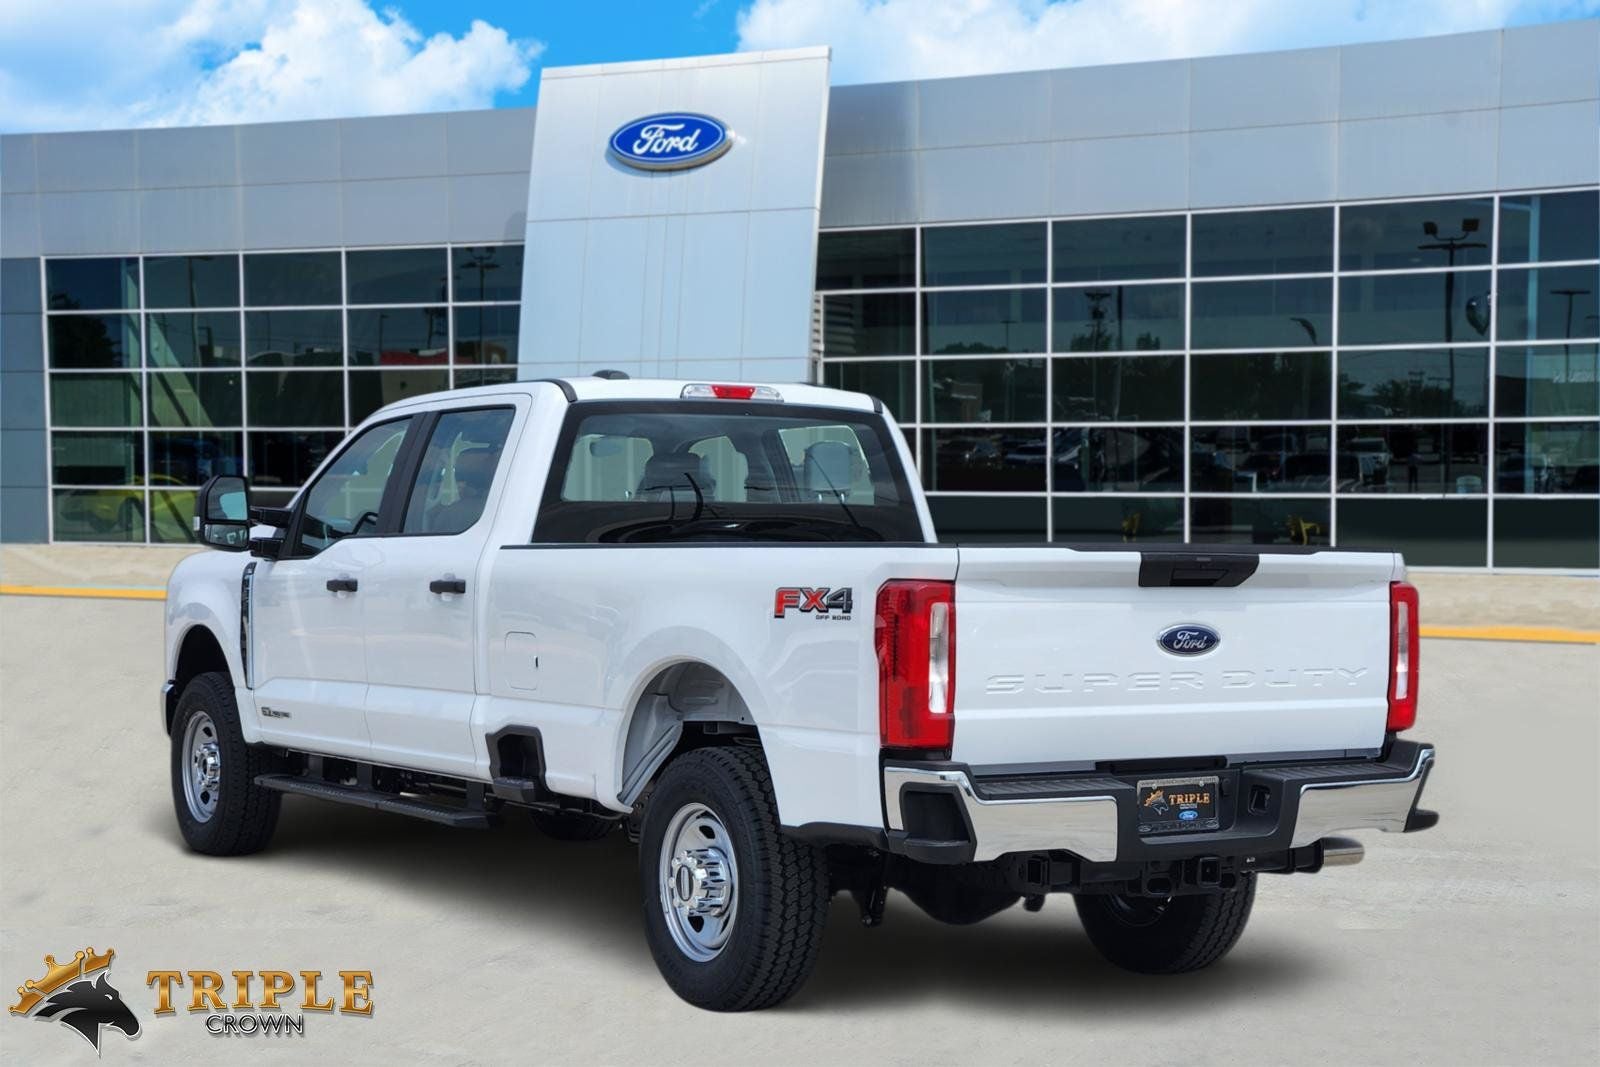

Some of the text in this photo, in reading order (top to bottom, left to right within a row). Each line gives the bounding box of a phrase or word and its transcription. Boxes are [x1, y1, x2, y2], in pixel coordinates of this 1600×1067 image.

[632, 123, 702, 155] Ford
[774, 587, 853, 618] FX4
[1173, 630, 1208, 649] Ford
[986, 666, 1369, 695] SUPER DUTY
[1169, 792, 1210, 805] TRIPLE
